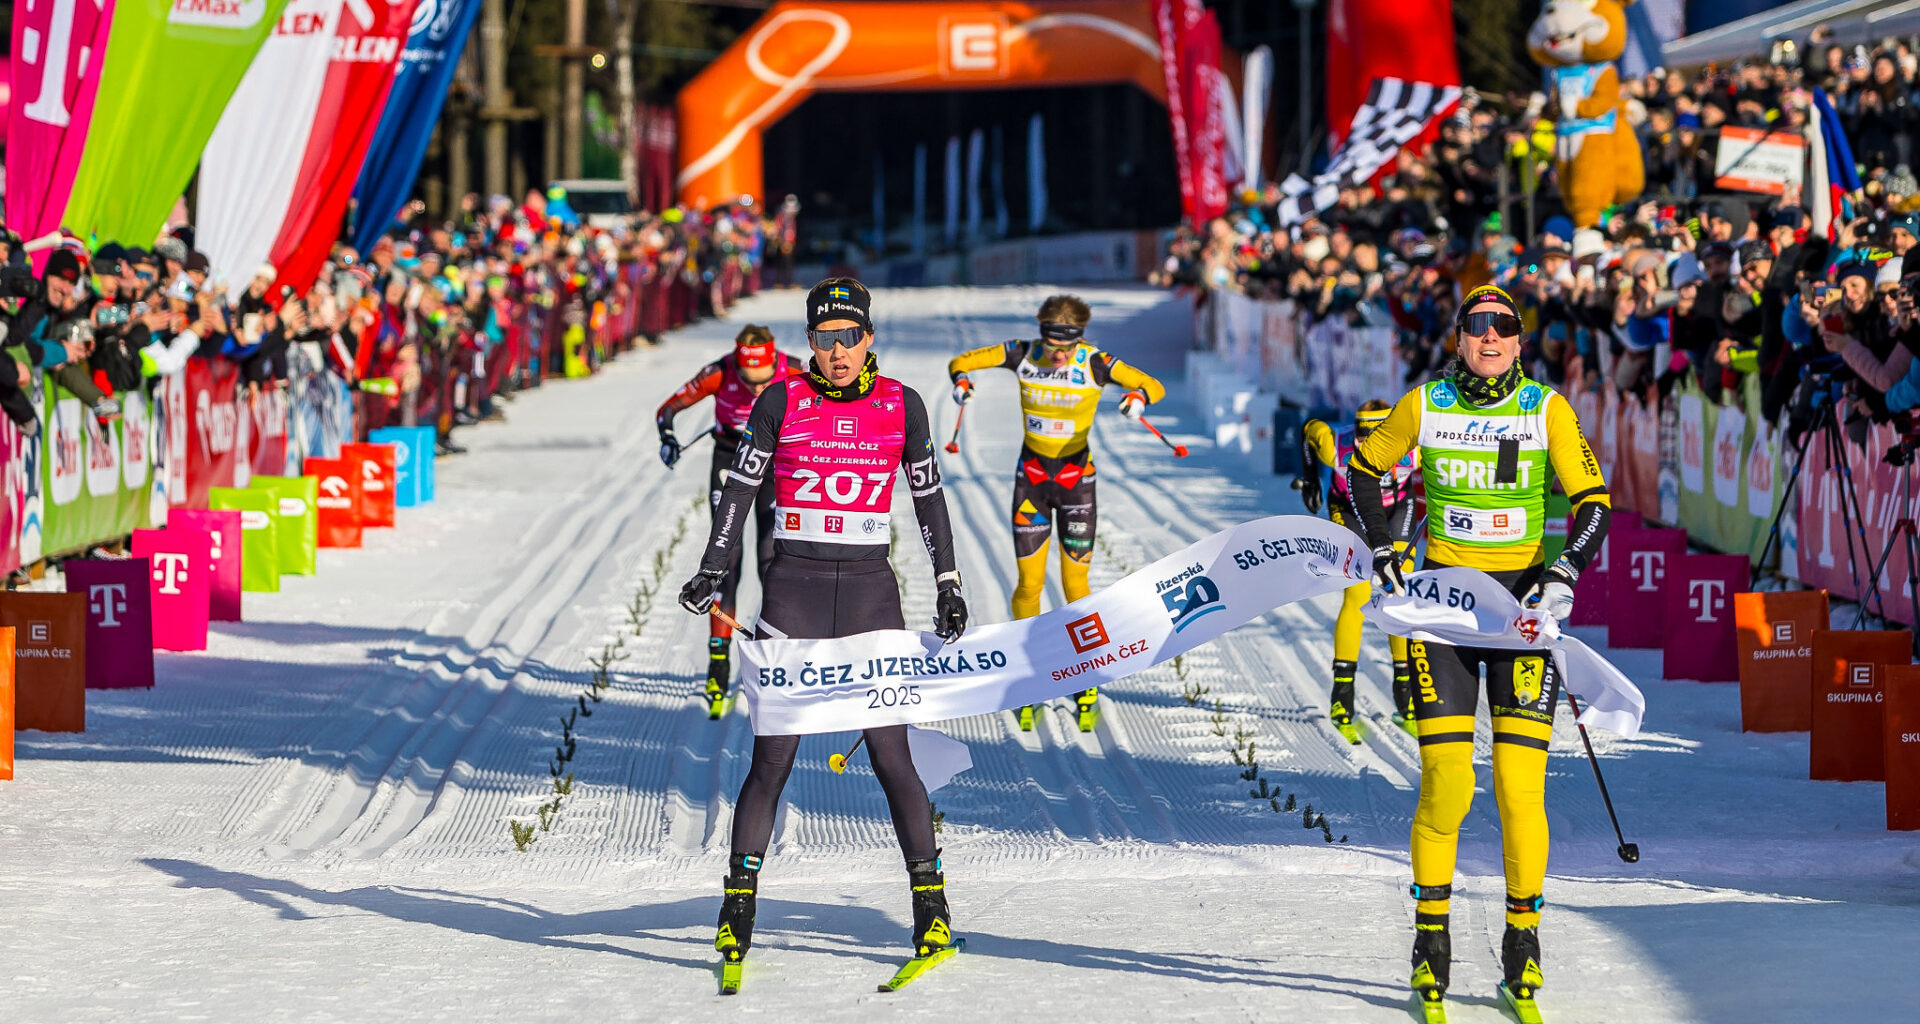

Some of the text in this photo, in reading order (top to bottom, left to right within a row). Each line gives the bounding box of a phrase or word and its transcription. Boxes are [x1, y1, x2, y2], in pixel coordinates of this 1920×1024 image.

[832, 303, 864, 317] Moelven
[810, 440, 880, 451] SKUPINA ČEZ
[1436, 431, 1533, 441] PROXCSKIING.COM
[812, 454, 831, 463] ČEZ
[832, 457, 878, 465] JIZERSKÁ
[878, 458, 888, 466] 50
[1435, 457, 1533, 490] SPRIT
[792, 468, 892, 506] 207
[721, 502, 737, 536] Moelven
[1449, 515, 1473, 531] 50
[1233, 549, 1265, 570] 58.
[1258, 539, 1296, 560] ČEZ
[1155, 562, 1204, 594] Jizerská
[1161, 575, 1220, 625] 50
[1447, 587, 1476, 612] 50
[51, 647, 72, 659] ČEZ
[1051, 639, 1149, 681] SKUPINA ČEZ
[1752, 648, 1797, 660] SKUPINA
[759, 650, 1007, 687] 58. ČEZ JIZERSKÁ 50
[866, 685, 922, 709] 2025
[1827, 692, 1873, 703] SKUPINA
